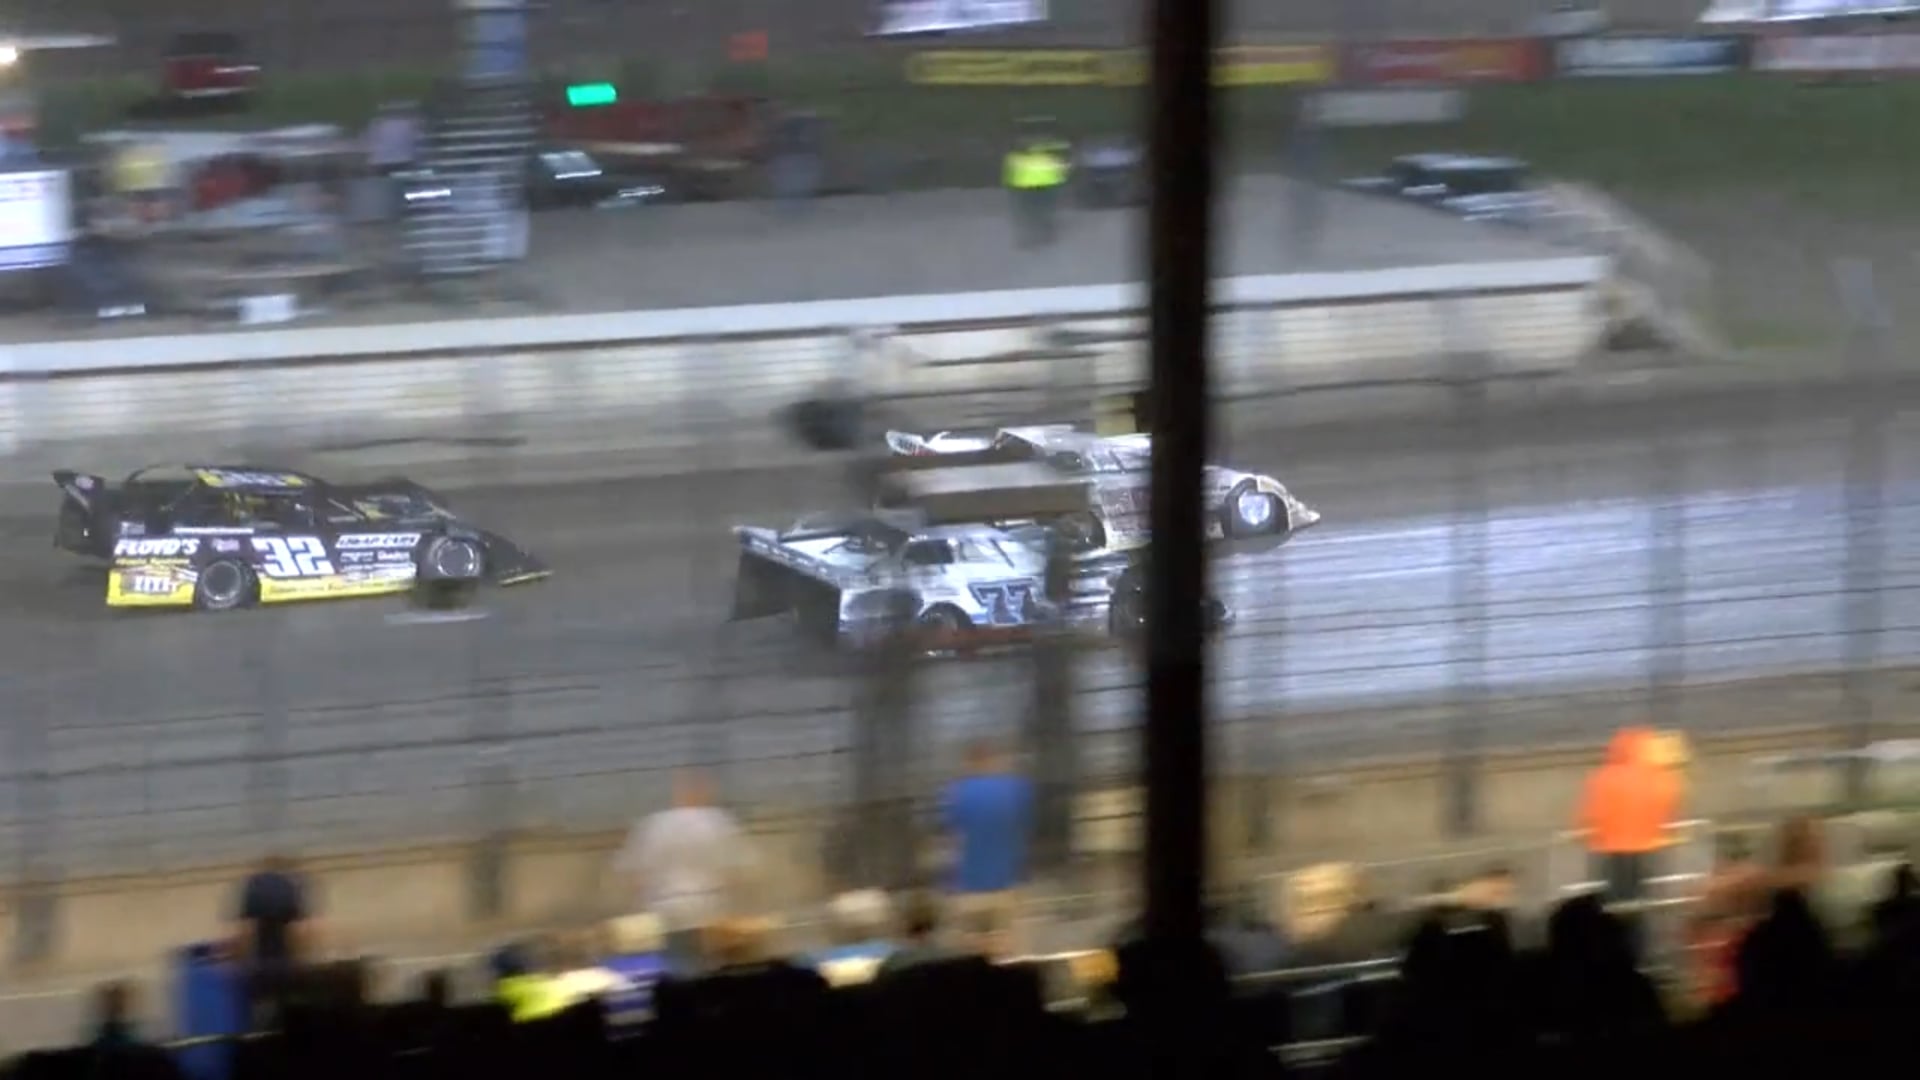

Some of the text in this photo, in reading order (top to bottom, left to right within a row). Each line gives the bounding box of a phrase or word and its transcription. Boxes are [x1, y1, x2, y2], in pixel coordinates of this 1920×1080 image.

[113, 538, 200, 556] FLOYD'S
[251, 536, 334, 577] 32
[967, 577, 1032, 625] 77
